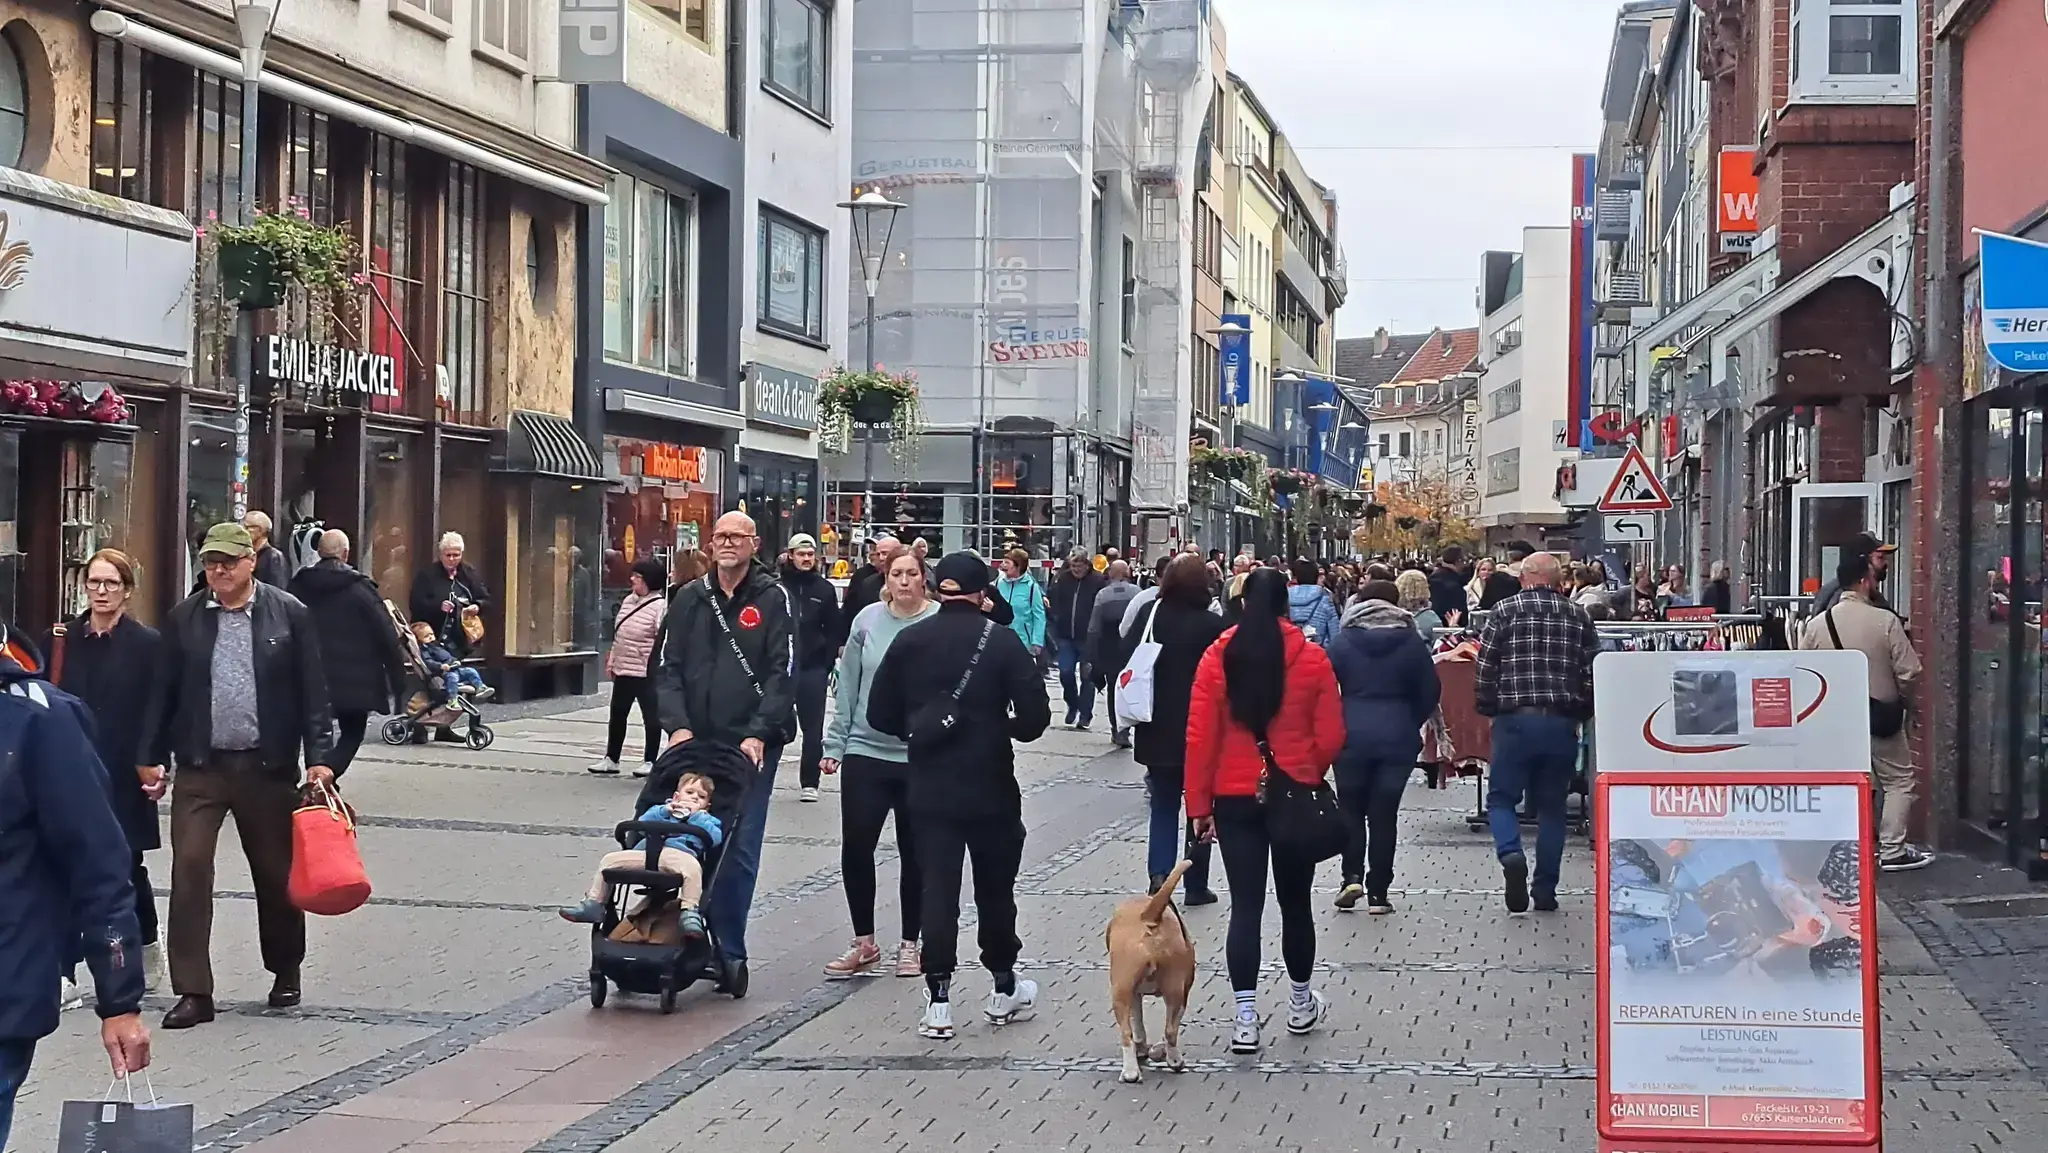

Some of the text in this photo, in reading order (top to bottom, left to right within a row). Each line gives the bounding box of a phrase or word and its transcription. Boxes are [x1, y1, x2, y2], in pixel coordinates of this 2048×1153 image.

[2013, 317, 2048, 333] Her
[268, 334, 399, 397] EMILIA JACKEL
[755, 371, 818, 423] dean & david
[1464, 414, 1477, 482] ERIKA
[1656, 785, 1821, 813] KHAN MOBILE
[1619, 1004, 1862, 1023] REPARATUREN in eine Stunde
[1700, 1028, 1778, 1042] LEISTUNGEN
[1648, 1103, 1699, 1117] MOBILE
[1755, 1103, 1830, 1114] Fackelstr. 19-21
[1774, 1114, 1844, 1125] Kaiserslautern
